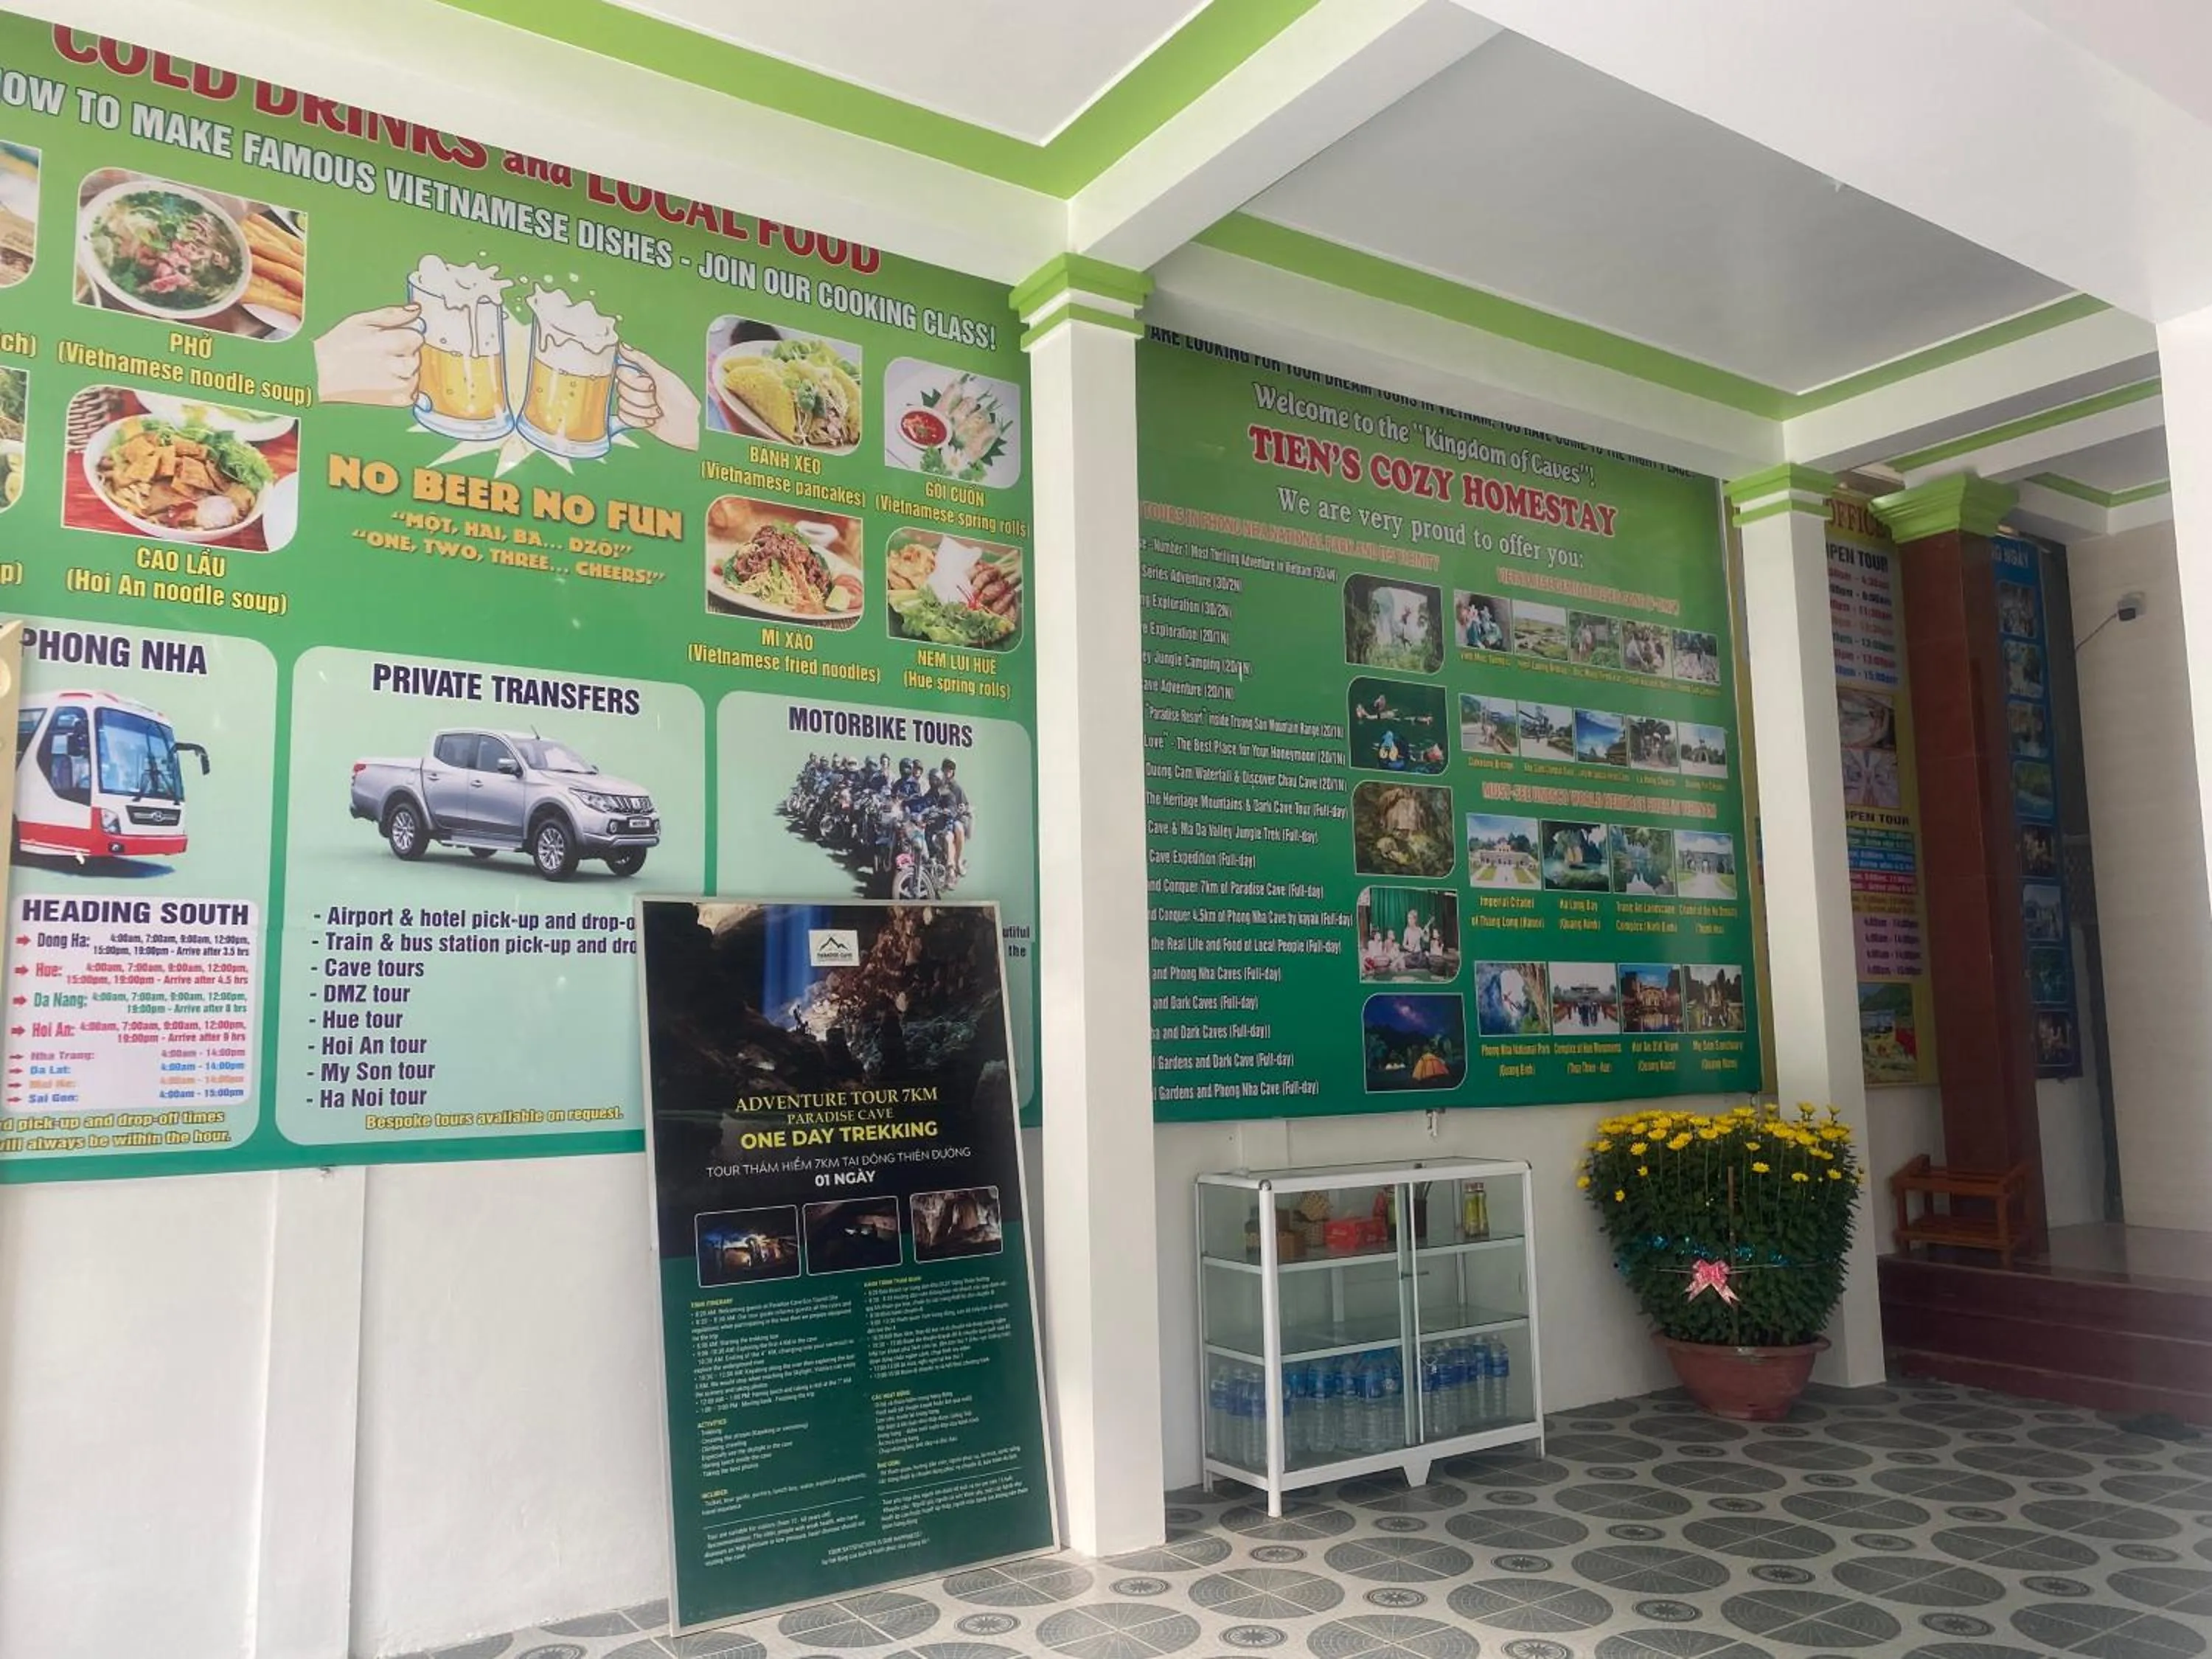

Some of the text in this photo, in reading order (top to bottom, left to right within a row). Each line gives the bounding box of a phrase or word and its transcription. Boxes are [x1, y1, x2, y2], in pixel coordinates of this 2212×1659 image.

[0, 68, 997, 351] OW TO MAKE FAMOUS VIETNAMESE DISHES JOIN OUR COOKING CLASS!
[58, 340, 313, 408] (Vietnamese noodle soup)
[1253, 382, 1349, 429] Welcome
[1353, 411, 1374, 435] to
[1378, 415, 1410, 444] the
[700, 459, 866, 509] (Vietnamese pancakes)
[1369, 454, 1455, 504] COZY
[1461, 473, 1620, 539] HOMESTAY
[328, 453, 684, 541] NO BEER NO FUN
[875, 493, 955, 523] (Vietnamese
[957, 512, 998, 535] spring
[1276, 485, 1585, 570] We are very proud to offer you:
[136, 546, 179, 572] CAO
[424, 538, 484, 563] TWO,
[1857, 550, 1889, 573] TOUR
[66, 568, 288, 616] (Hoi An noodle soup)
[140, 639, 209, 675] NHA
[687, 644, 883, 686] (Vietnamese fried noodles)
[917, 649, 947, 669] NEM
[372, 662, 641, 717] PRIVATE TRANSFERS
[903, 669, 1012, 702] (Hue spring rolls)
[787, 705, 974, 749] MOTORBIKE TOURS
[21, 899, 249, 926] HEADING SOUTH
[327, 906, 636, 933] Airport & hotel pick-up and drop-o
[37, 933, 69, 950] Dong
[325, 931, 608, 956] Train & bus station pick-up and
[1002, 926, 1031, 939] utiful
[1008, 945, 1027, 958] the
[324, 959, 425, 978] Cave tours
[1152, 967, 1168, 981] and
[1217, 967, 1242, 980] Caves
[34, 992, 50, 1007] Da
[324, 984, 411, 1004] DMZ tour
[322, 1010, 404, 1029] Hue tour
[321, 1035, 428, 1056] Hoi An tour
[320, 1061, 437, 1084] My Son tour
[319, 1086, 428, 1109] Ha Noi tour
[735, 1086, 939, 1113] ADVENTURE TOUR 7KM
[1197, 1084, 1212, 1099] and
[1260, 1082, 1280, 1096] Cave
[18, 1110, 225, 1133] pick-up and drop-off times
[365, 1106, 625, 1131] Bespoke tours available on request.
[787, 1107, 894, 1125] PARADISE CAVE
[27, 1130, 232, 1152] always be within the hour.
[740, 1120, 939, 1151] ONE DAY TREKKING
[706, 1165, 741, 1178] TOUR
[814, 1158, 841, 1170] 7KM
[814, 1174, 830, 1187] 01
